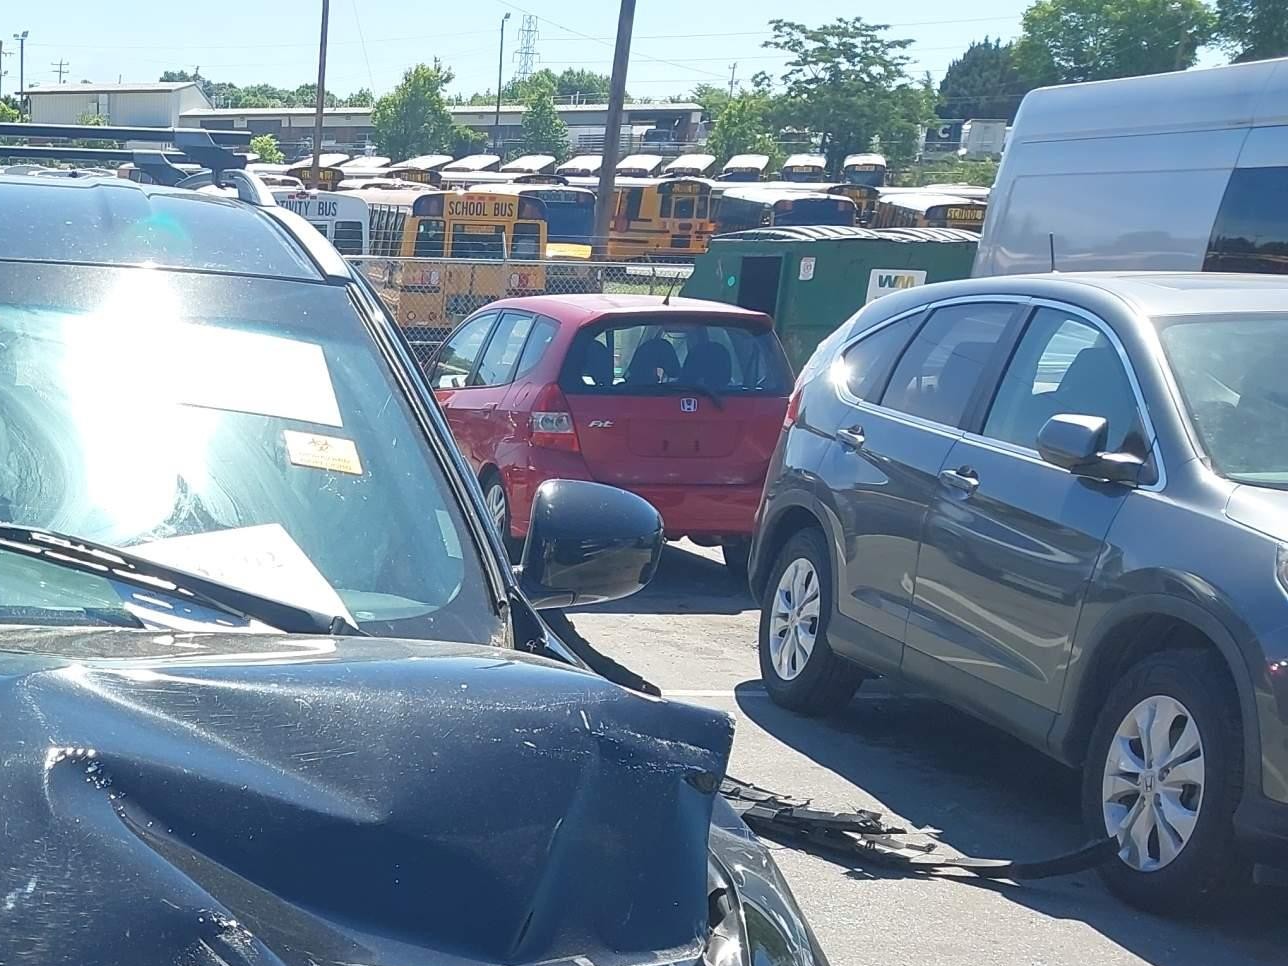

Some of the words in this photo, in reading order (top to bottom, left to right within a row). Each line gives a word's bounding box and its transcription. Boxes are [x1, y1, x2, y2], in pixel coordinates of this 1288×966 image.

[318, 201, 337, 217] BUS
[448, 201, 488, 217] SCHOOL
[493, 202, 514, 217] BUS
